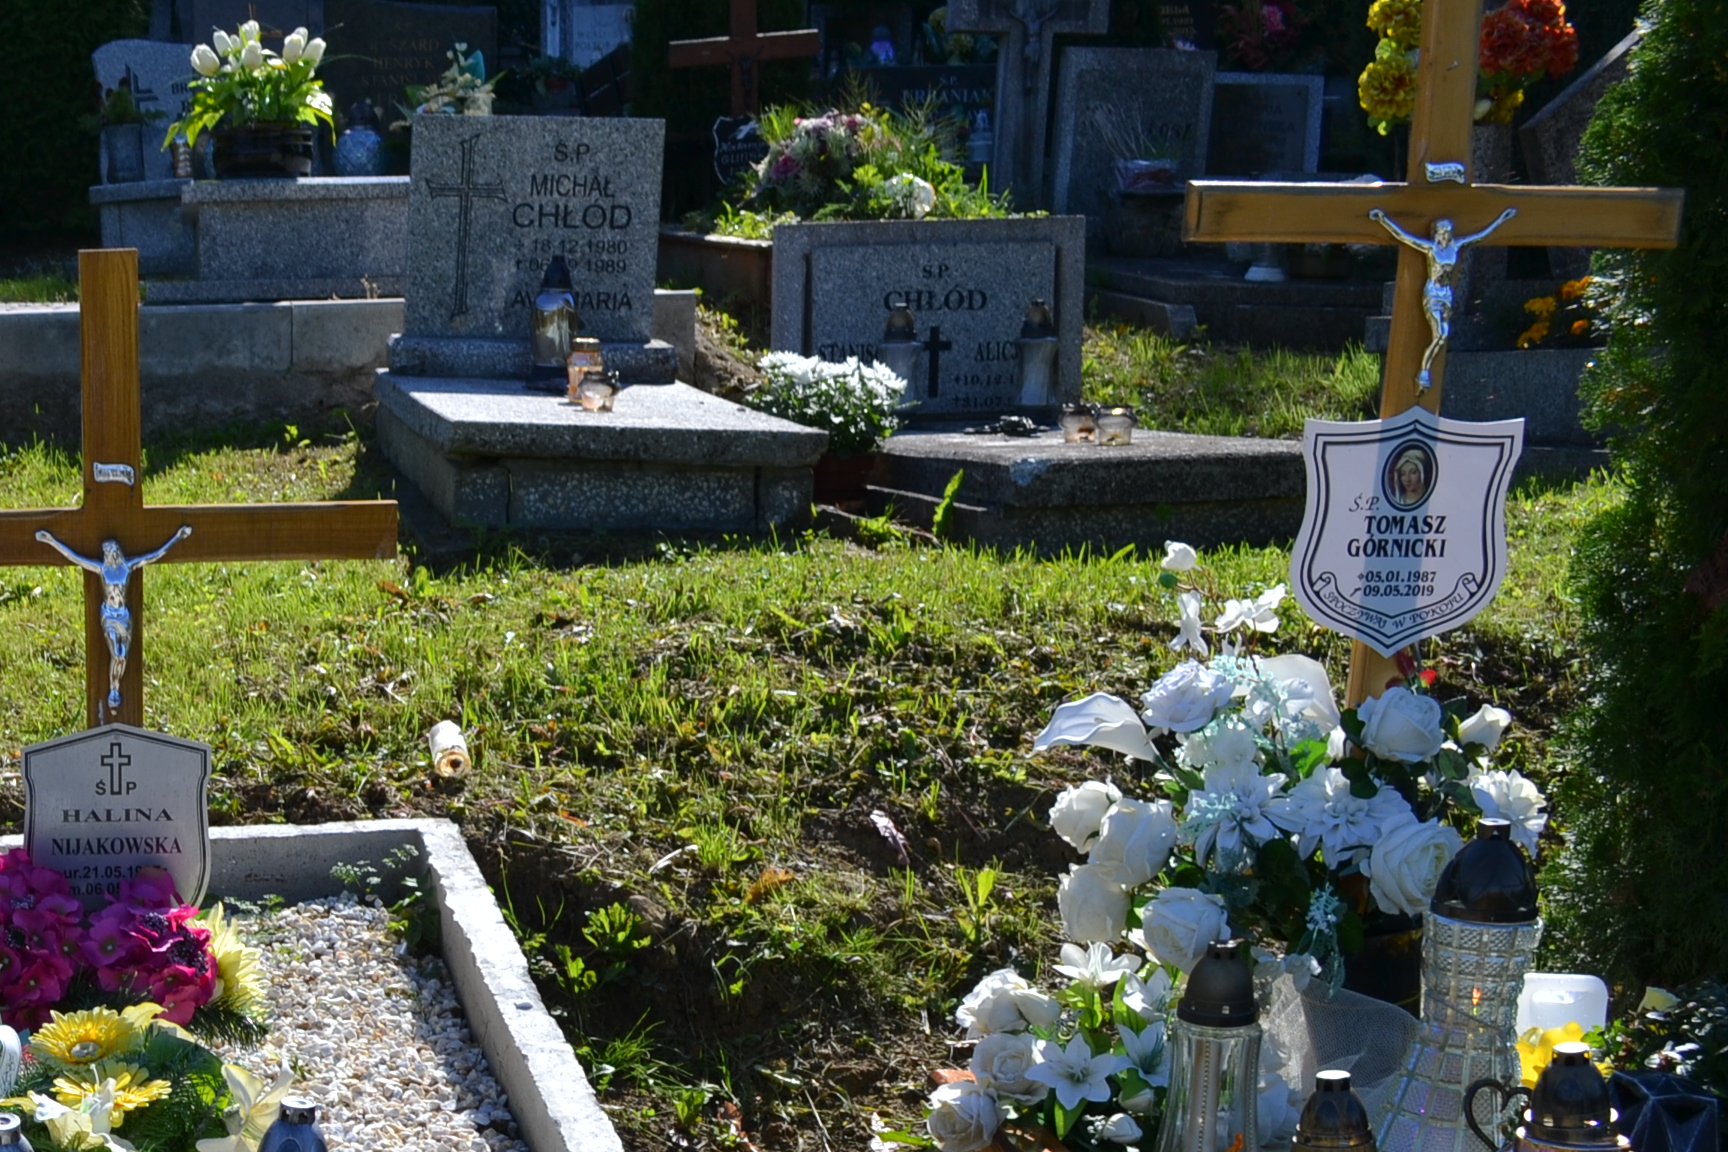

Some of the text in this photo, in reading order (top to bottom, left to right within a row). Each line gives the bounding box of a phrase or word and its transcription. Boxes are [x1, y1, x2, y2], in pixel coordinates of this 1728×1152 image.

[530, 174, 615, 198] MICHAŁ
[512, 199, 632, 229] CHŁÓD
[884, 284, 988, 312] CHŁÓD
[973, 342, 1019, 362] ALICJ
[1364, 515, 1447, 535] TOMASZ
[1347, 534, 1447, 558] GÓRNICKI
[1365, 570, 1437, 583] 05.01.1987
[1363, 585, 1435, 597] 09.05.2019
[62, 808, 174, 823] HALINA
[51, 837, 182, 857] NIJAKOWSKA
